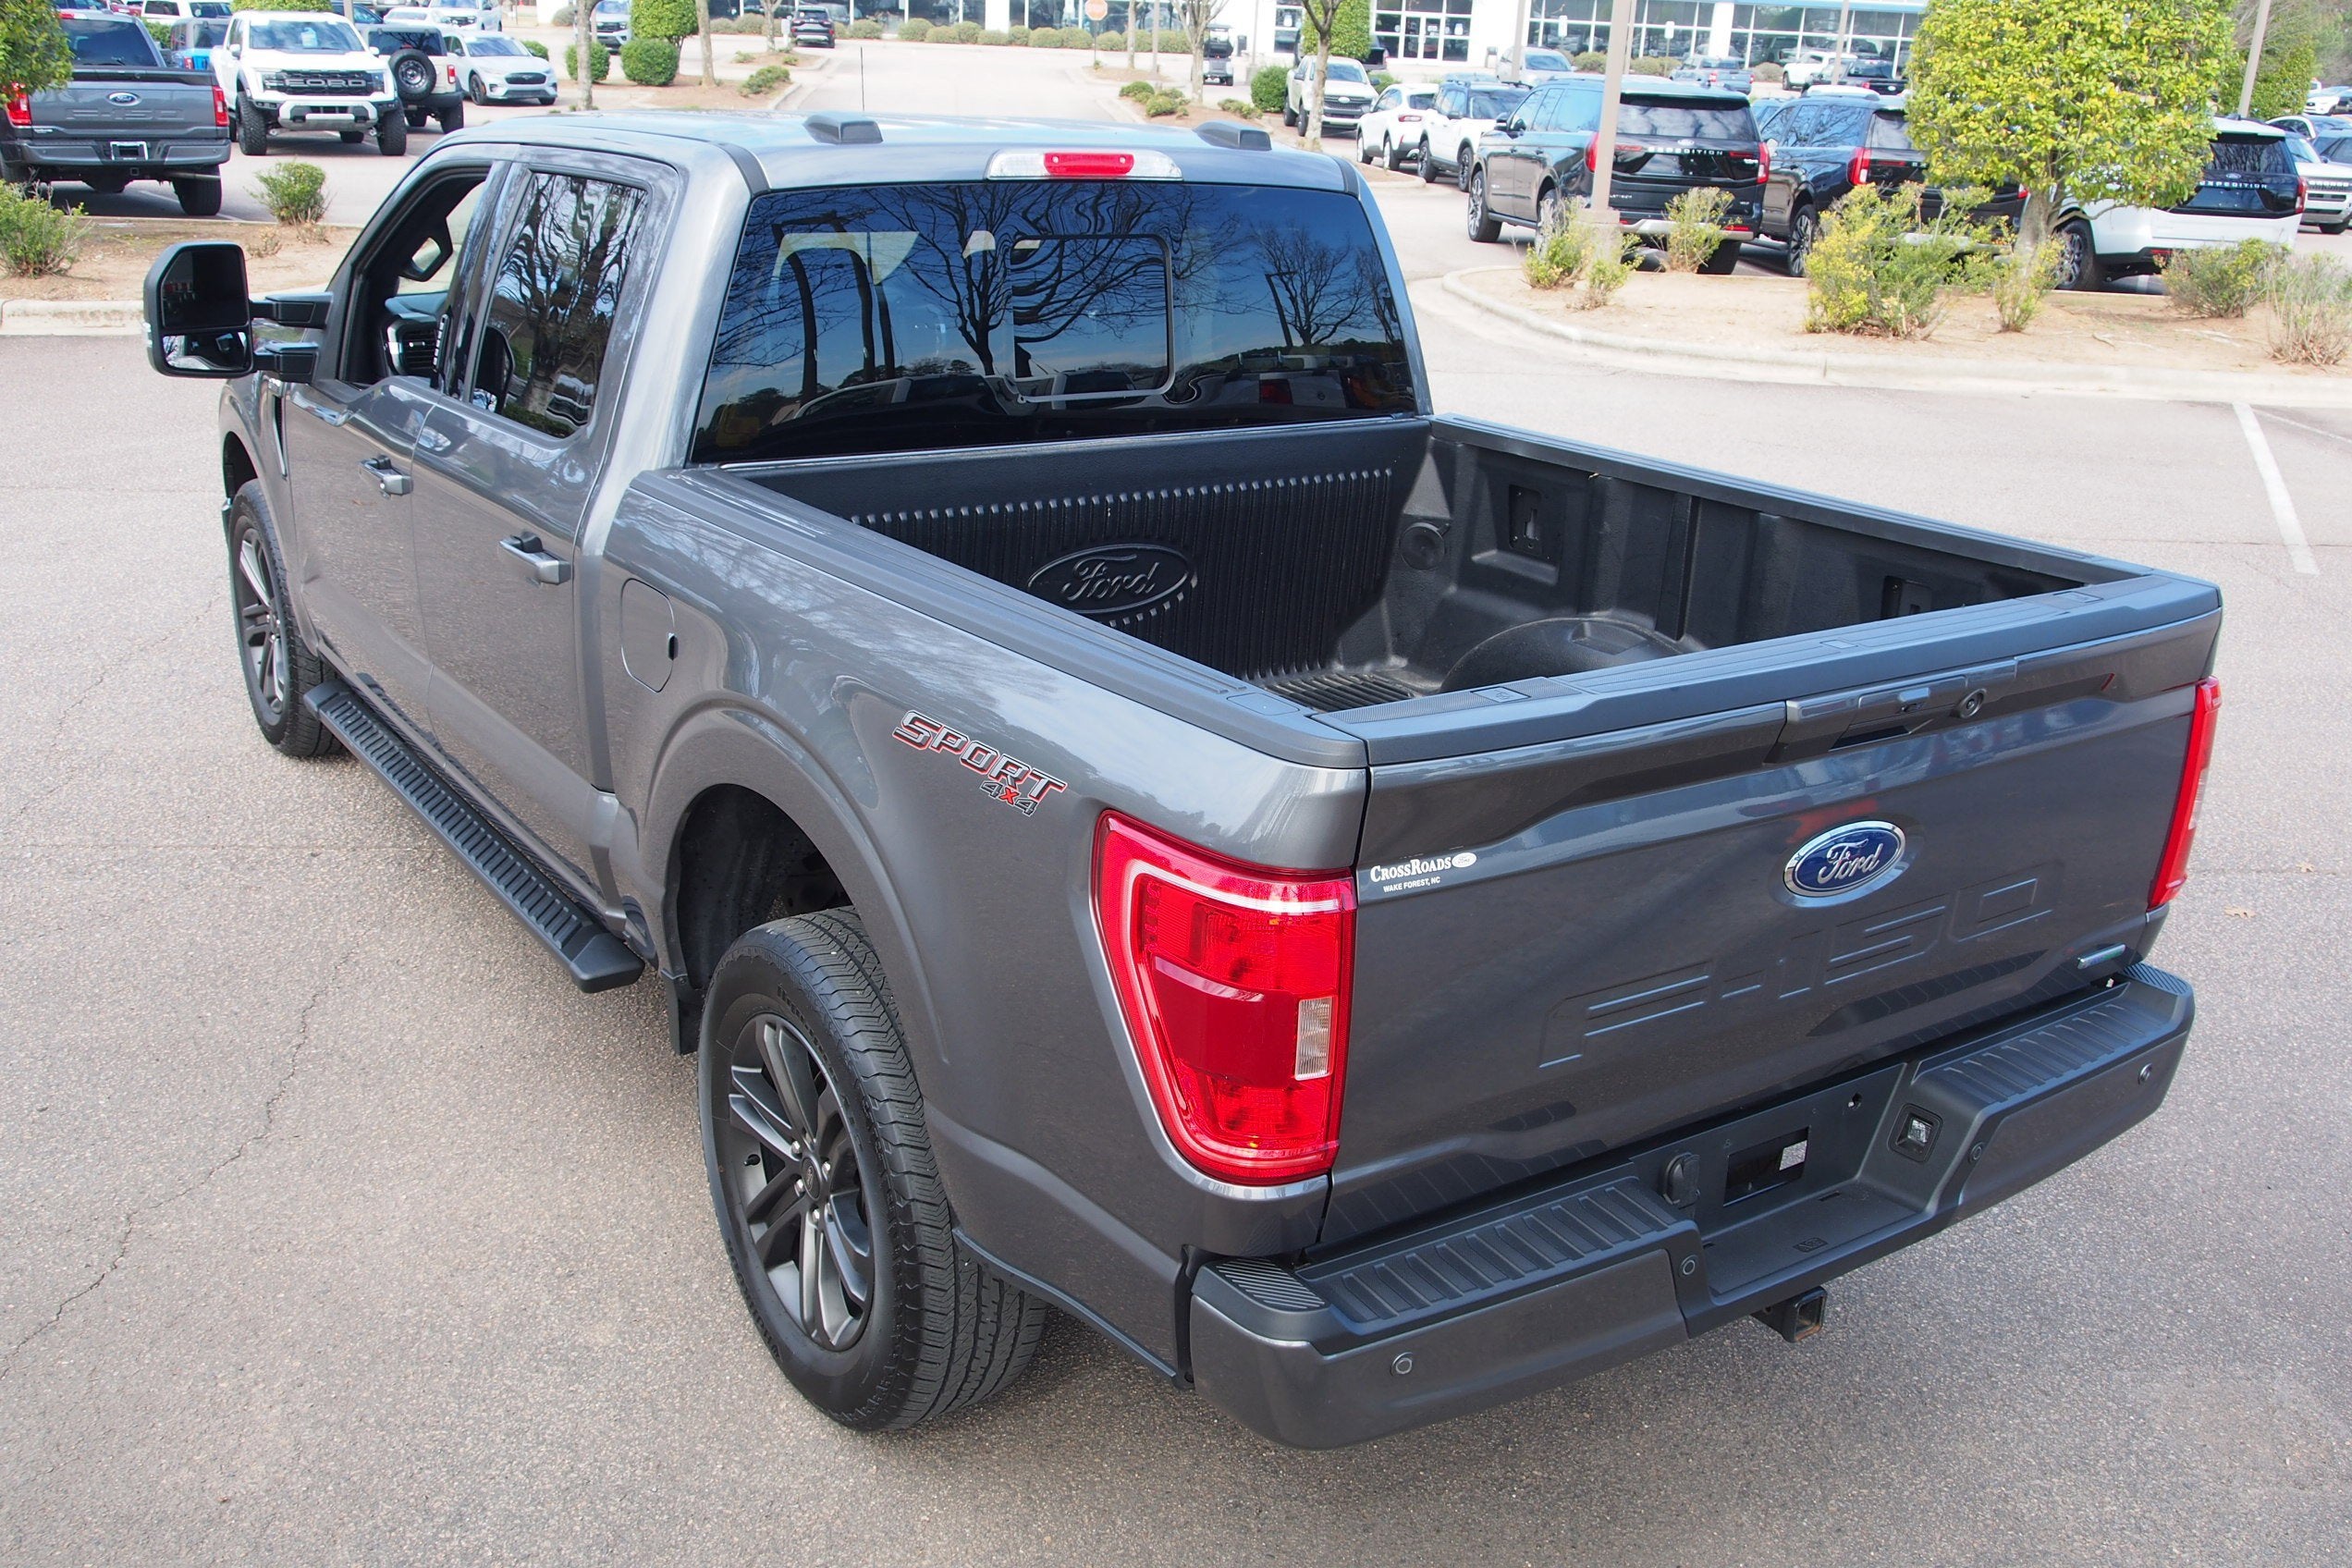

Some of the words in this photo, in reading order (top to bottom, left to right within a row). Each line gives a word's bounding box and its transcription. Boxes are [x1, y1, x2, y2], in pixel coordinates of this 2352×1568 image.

[286, 78, 367, 88] FORD
[1062, 555, 1159, 601] Ford
[892, 710, 1068, 802] SPORT
[1817, 838, 1884, 884] Ford
[1383, 881, 1403, 893] WAKE
[1431, 876, 1440, 885] NC
[1537, 861, 2064, 1070] F-150
